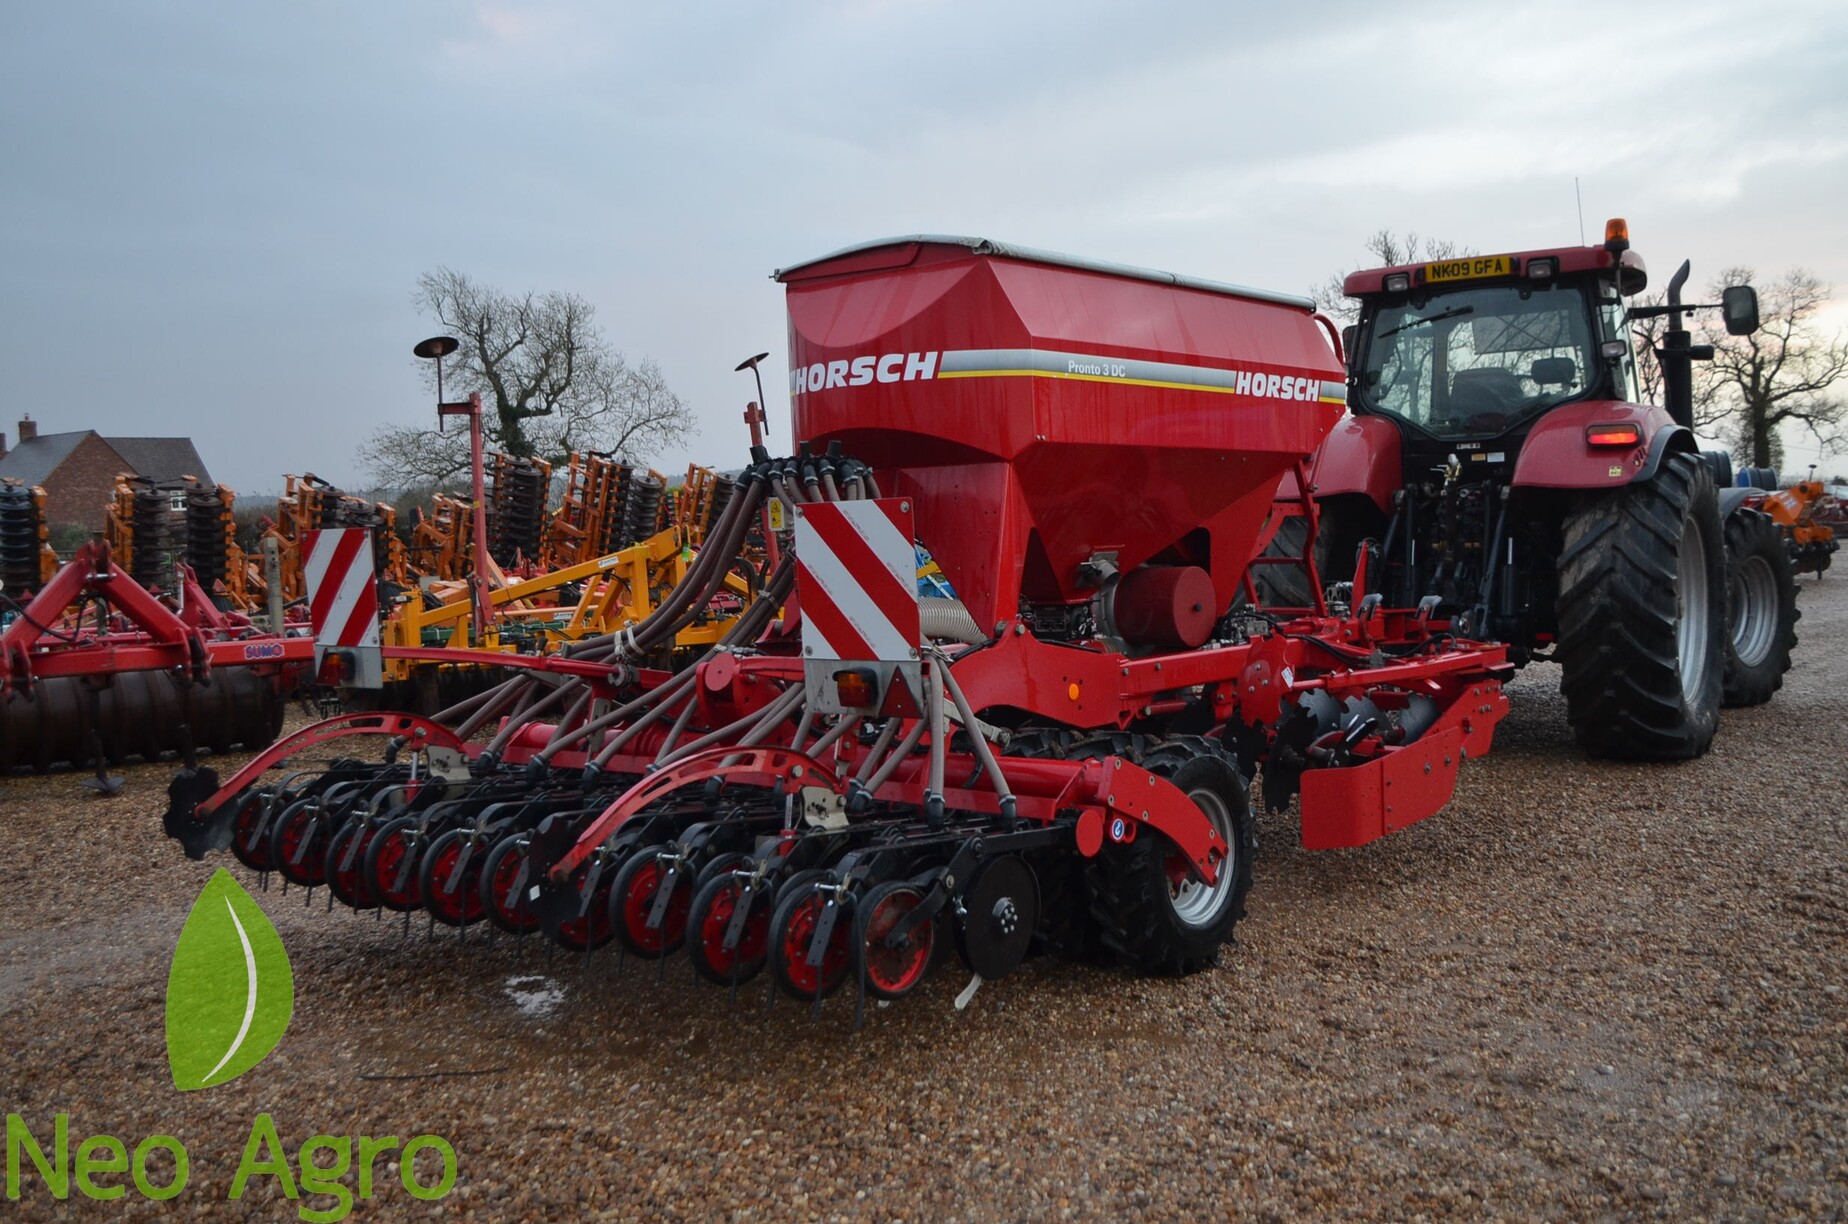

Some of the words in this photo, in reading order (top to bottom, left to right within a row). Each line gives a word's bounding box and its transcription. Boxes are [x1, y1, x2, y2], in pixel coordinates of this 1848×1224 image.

[1431, 262, 1470, 279] NK09
[1474, 258, 1503, 274] GFA
[795, 351, 938, 395] HORSCH
[1068, 360, 1101, 375] Pronto
[1102, 363, 1109, 376] 3
[1111, 364, 1126, 378] DC
[1236, 370, 1320, 402] HORSCH
